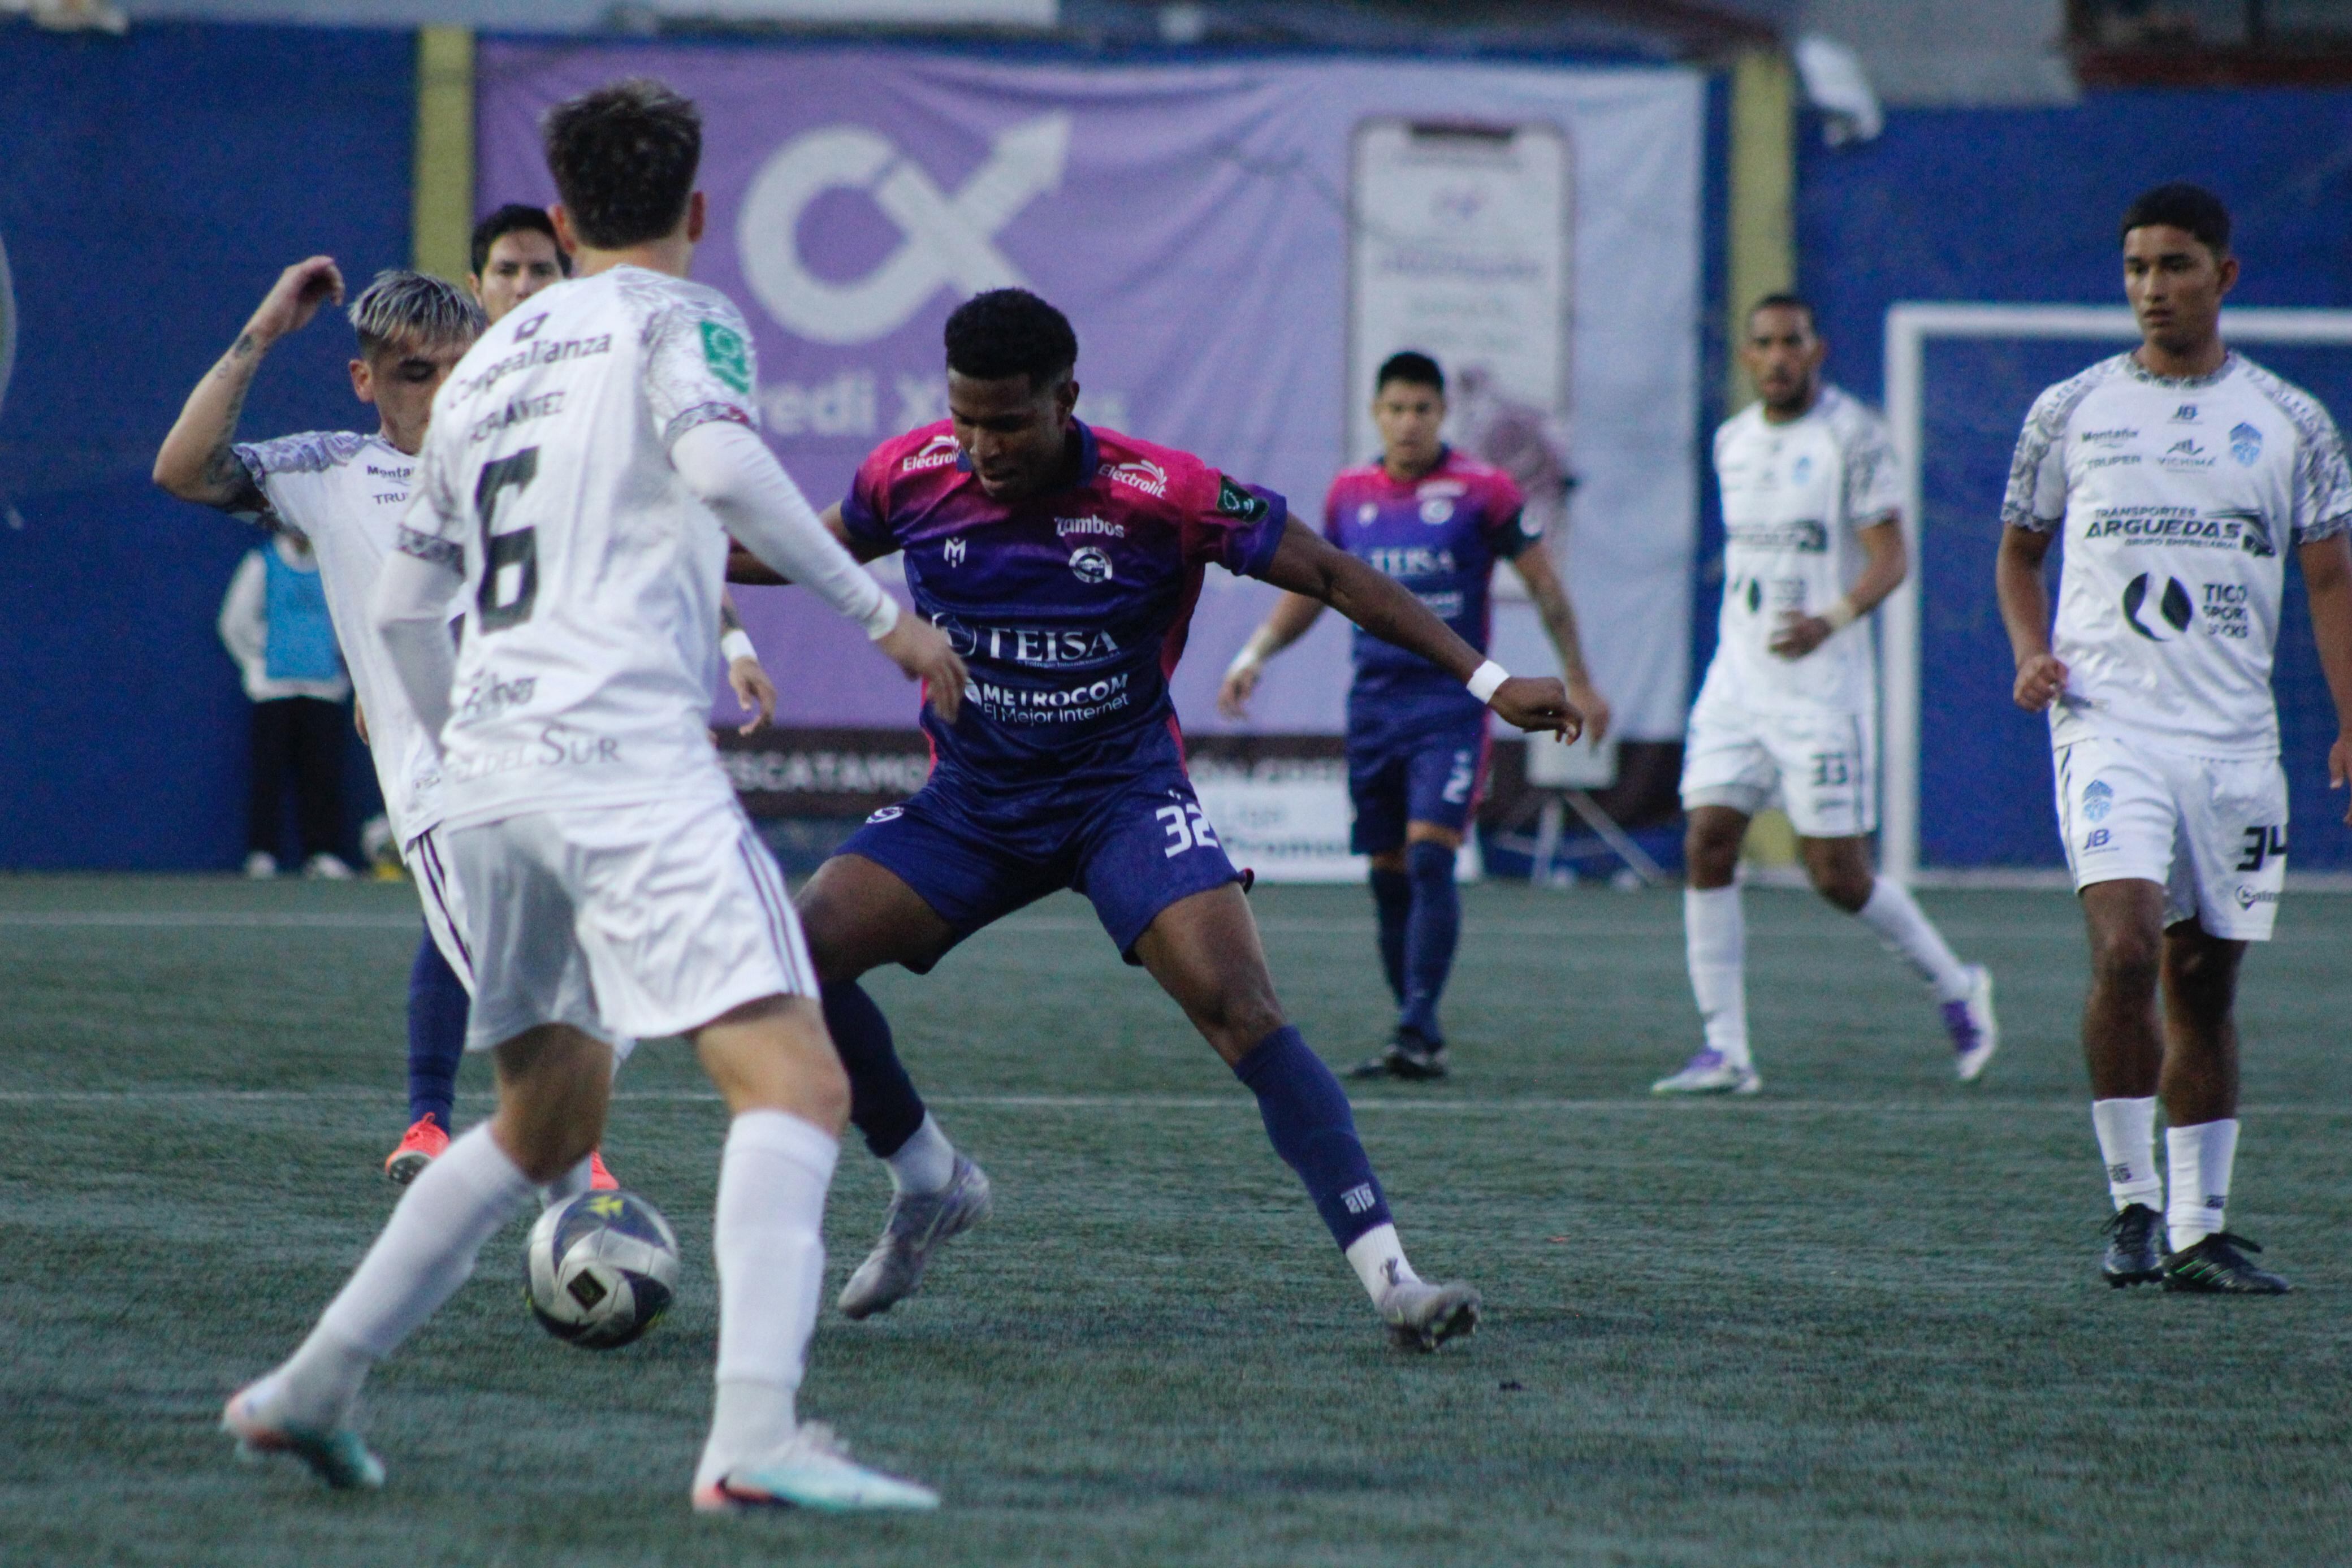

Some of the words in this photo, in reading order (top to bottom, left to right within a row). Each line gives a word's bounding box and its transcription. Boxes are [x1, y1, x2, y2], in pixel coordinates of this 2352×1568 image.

[367, 465, 415, 479] Monta
[1098, 464, 1166, 498] Electrolit
[373, 492, 408, 505] TRU
[474, 446, 541, 636] 6
[2085, 518, 2243, 538] ARGUEDAS
[982, 626, 1118, 661] TEISA
[983, 673, 1129, 707] METROCOM
[984, 703, 997, 721] El
[1001, 706, 1053, 726] Mejor
[1059, 692, 1129, 722] Internet
[1156, 802, 1219, 859] 32
